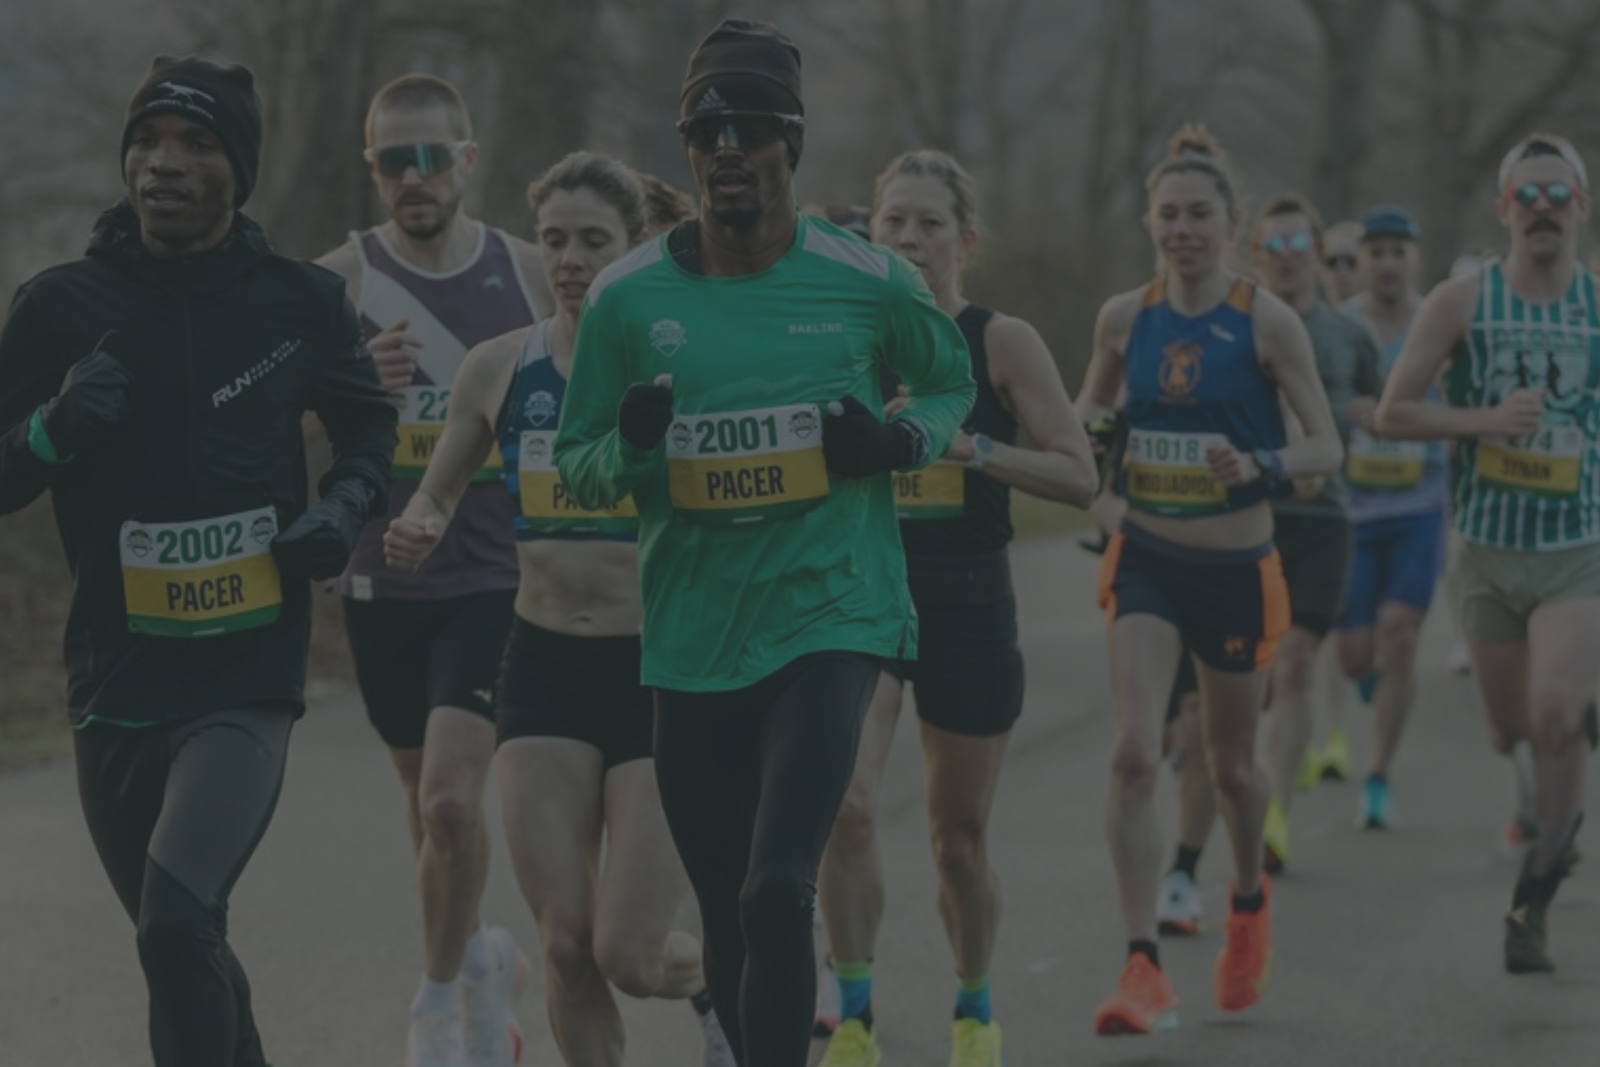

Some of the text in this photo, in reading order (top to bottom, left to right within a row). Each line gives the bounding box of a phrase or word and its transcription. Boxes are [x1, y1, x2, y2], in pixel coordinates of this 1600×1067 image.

[211, 371, 252, 409] RUN
[694, 413, 779, 454] 2001
[1144, 437, 1200, 462] 1018
[705, 465, 785, 501] PACER
[155, 520, 244, 564] 2002
[165, 573, 245, 612] PACER
